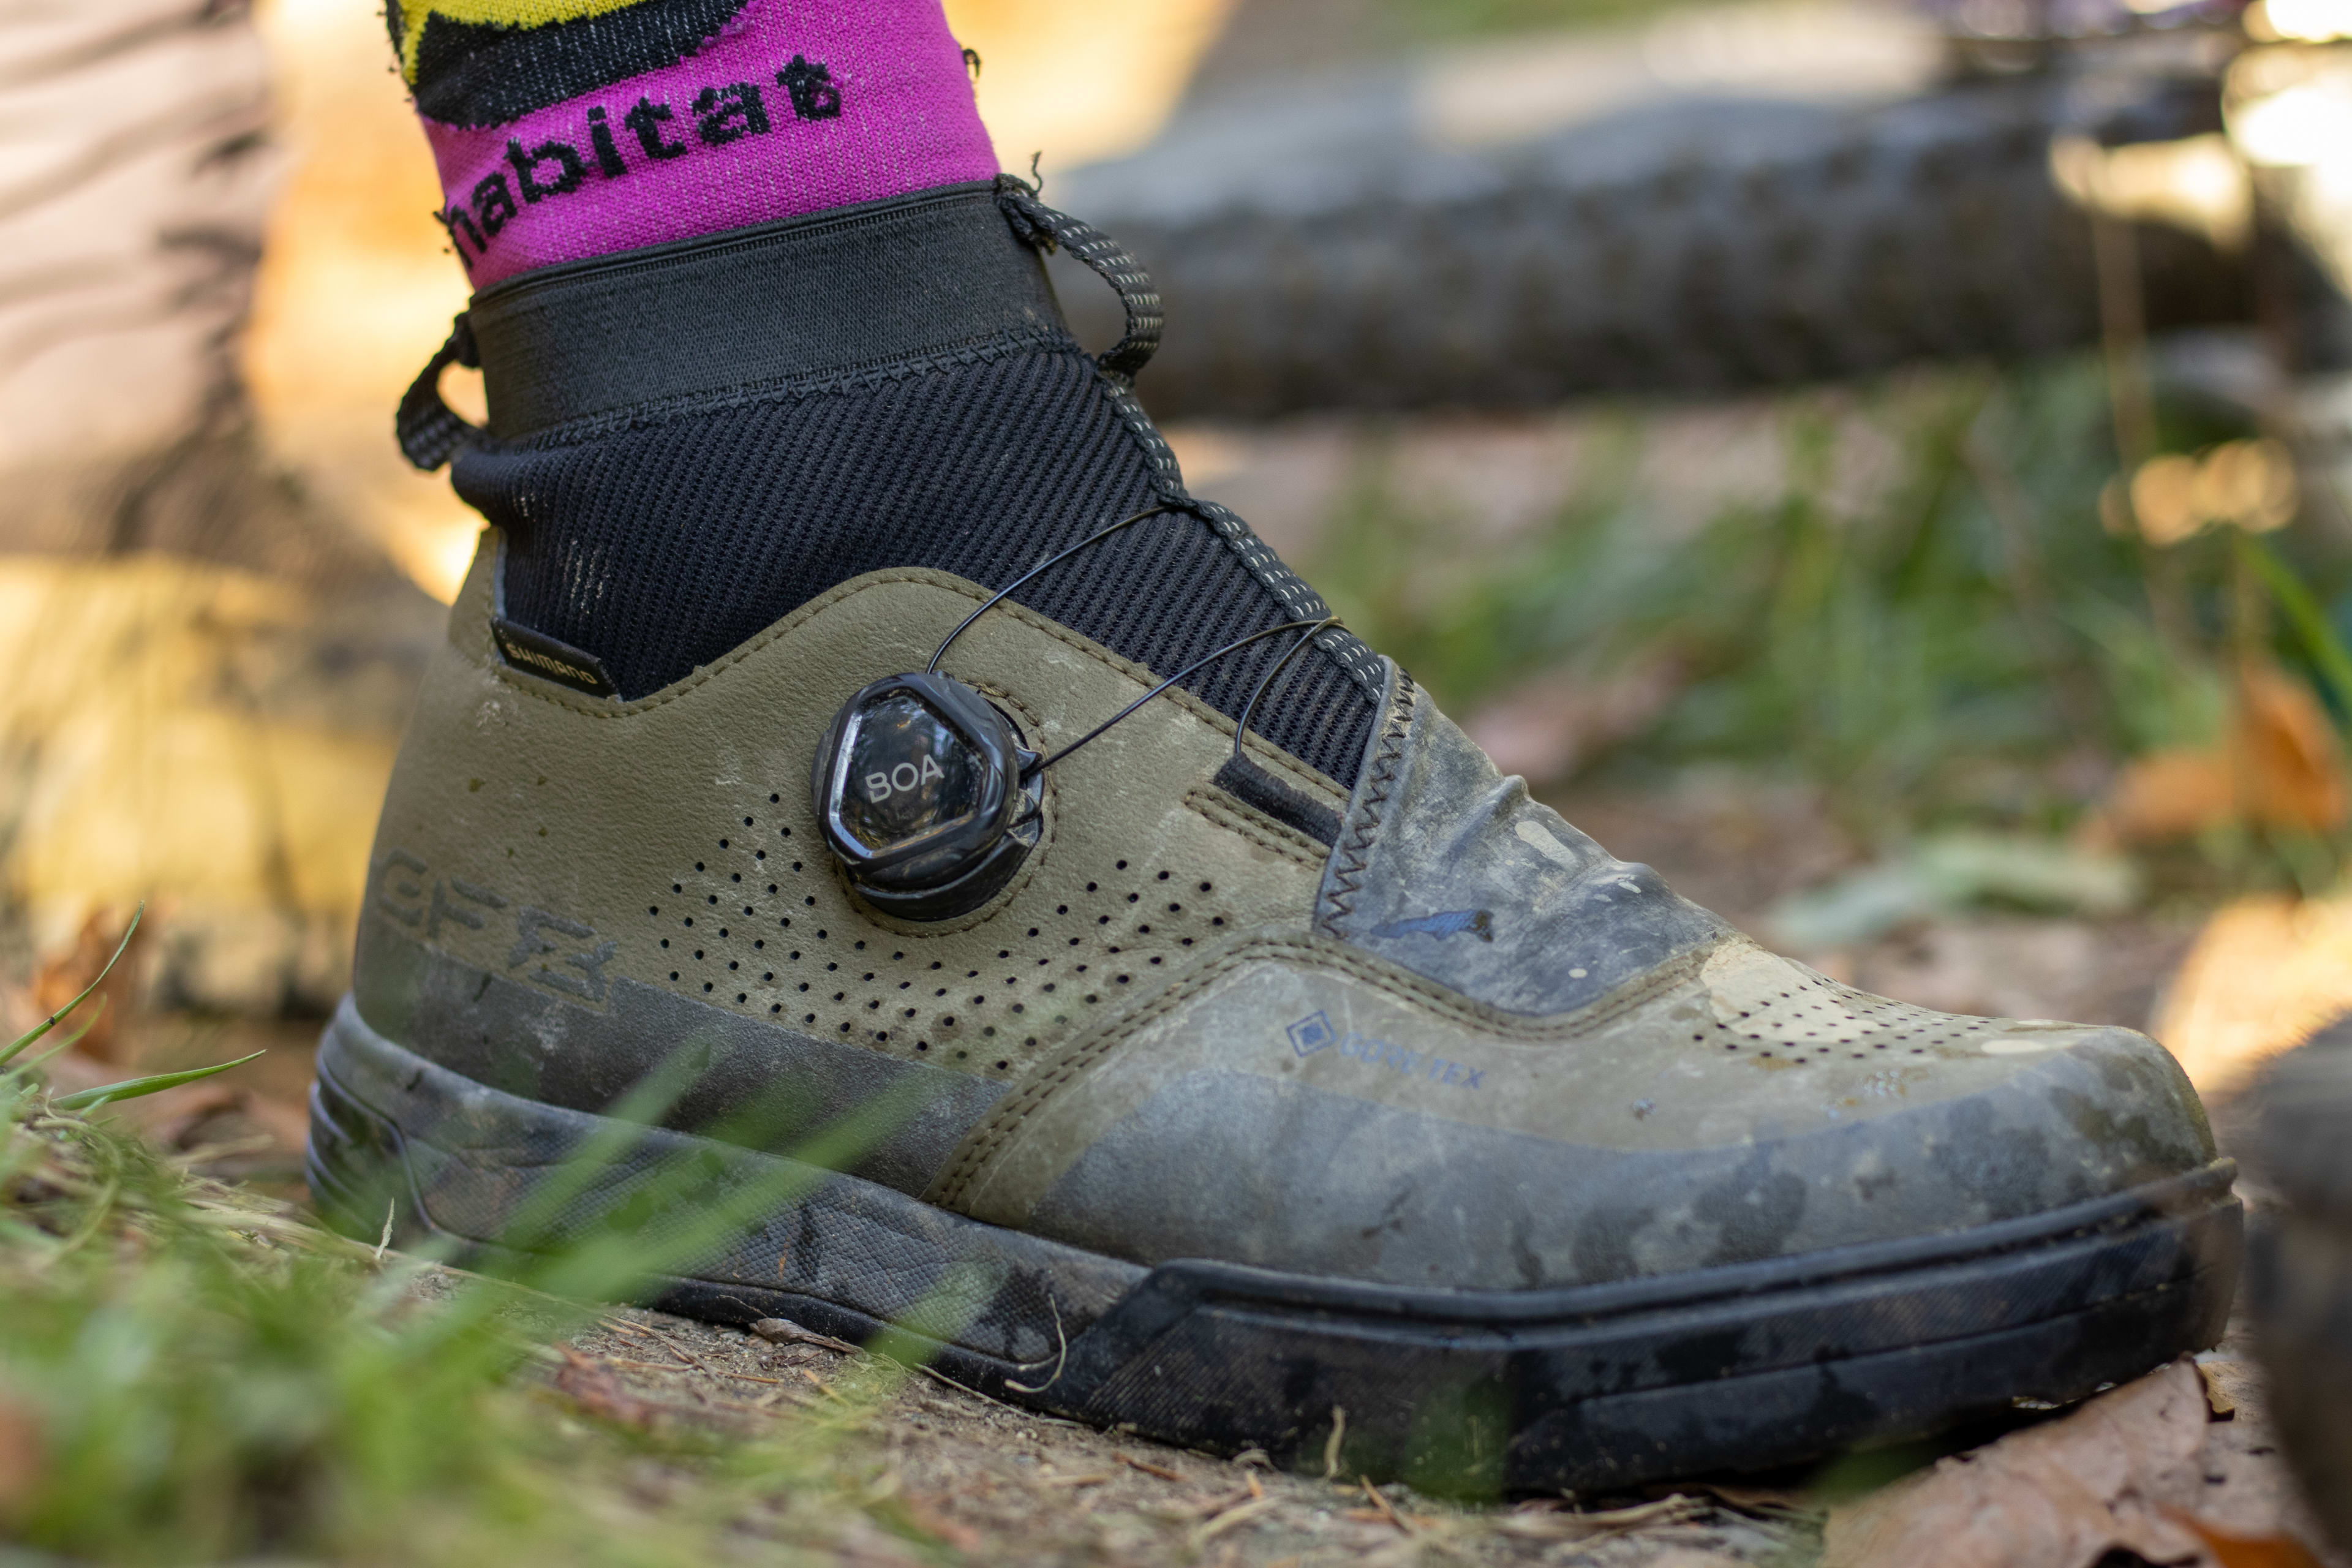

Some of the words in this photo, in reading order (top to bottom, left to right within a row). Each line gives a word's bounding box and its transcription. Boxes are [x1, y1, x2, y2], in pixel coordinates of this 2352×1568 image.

[505, 643, 598, 685] SHIMANO
[865, 753, 945, 804] BOA
[1340, 1031, 1487, 1090] GORETEX
